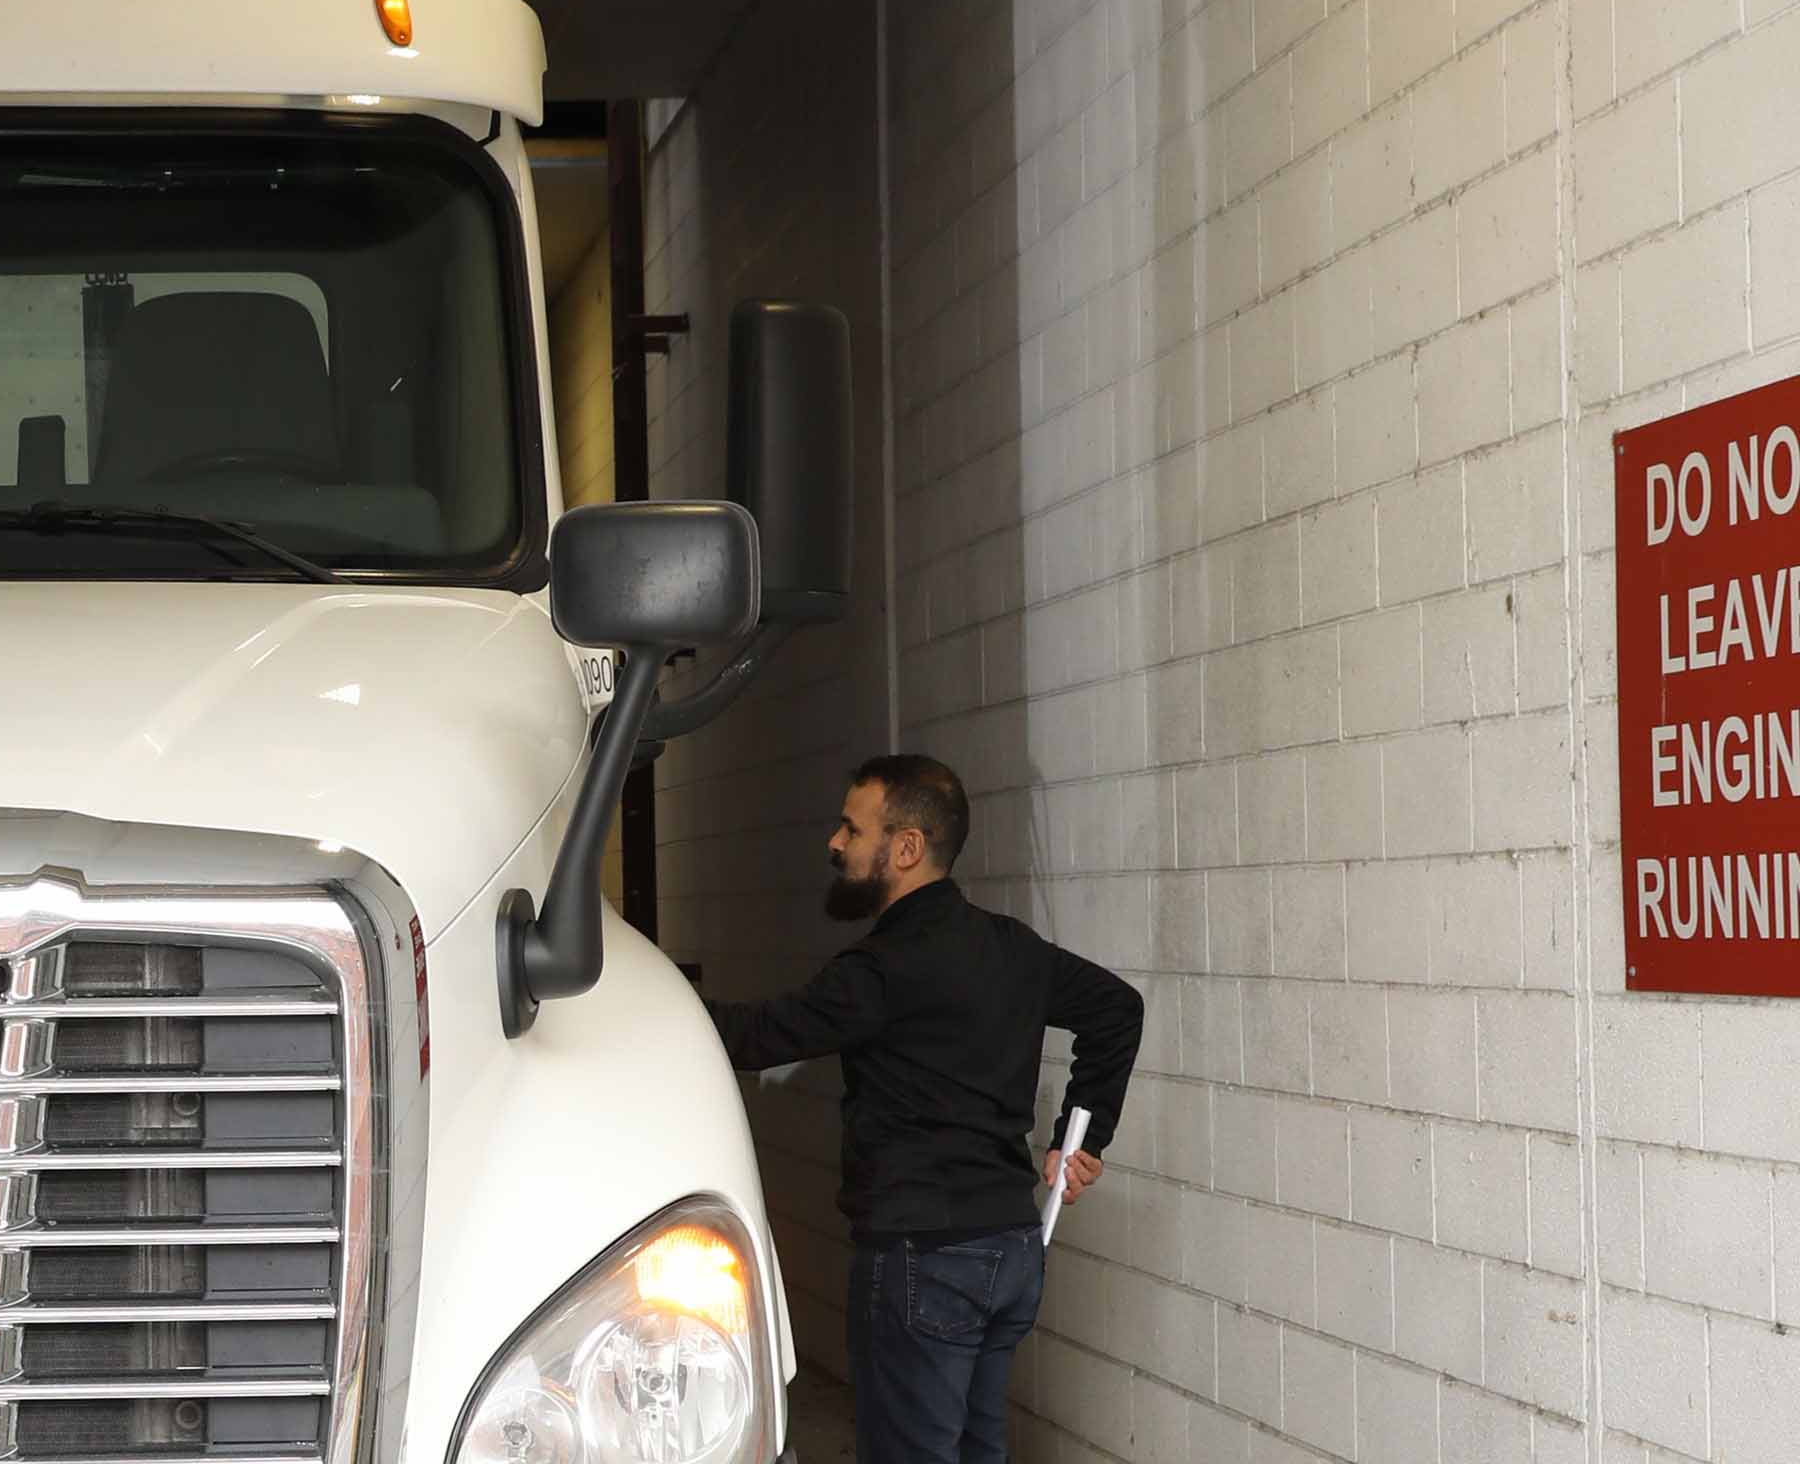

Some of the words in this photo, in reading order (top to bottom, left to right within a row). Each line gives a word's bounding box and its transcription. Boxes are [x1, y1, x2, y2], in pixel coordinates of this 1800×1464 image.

[1646, 451, 1713, 546] DO
[1728, 424, 1800, 525] NO
[1651, 709, 1800, 808] ENGIN
